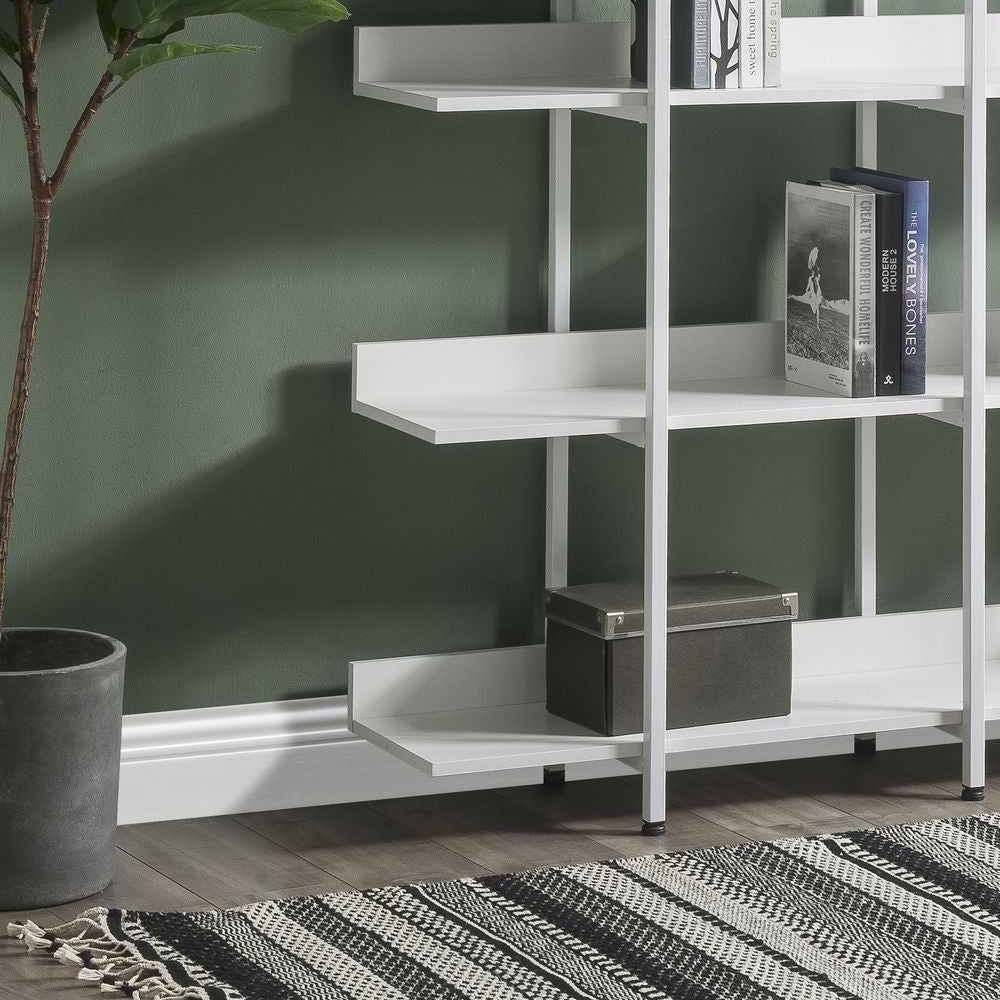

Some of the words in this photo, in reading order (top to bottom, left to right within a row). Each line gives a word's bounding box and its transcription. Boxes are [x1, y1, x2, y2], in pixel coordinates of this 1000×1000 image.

[746, 7, 756, 40] home
[768, 19, 779, 58] spring
[748, 43, 756, 76] sweet
[860, 200, 872, 234] CREATE
[910, 211, 918, 227] THE
[859, 237, 872, 296] WONDERFUL
[889, 258, 897, 292] HOUSE
[906, 230, 918, 295] LOVELY
[858, 298, 871, 346] HOMELIFE
[905, 299, 917, 356] BONES
